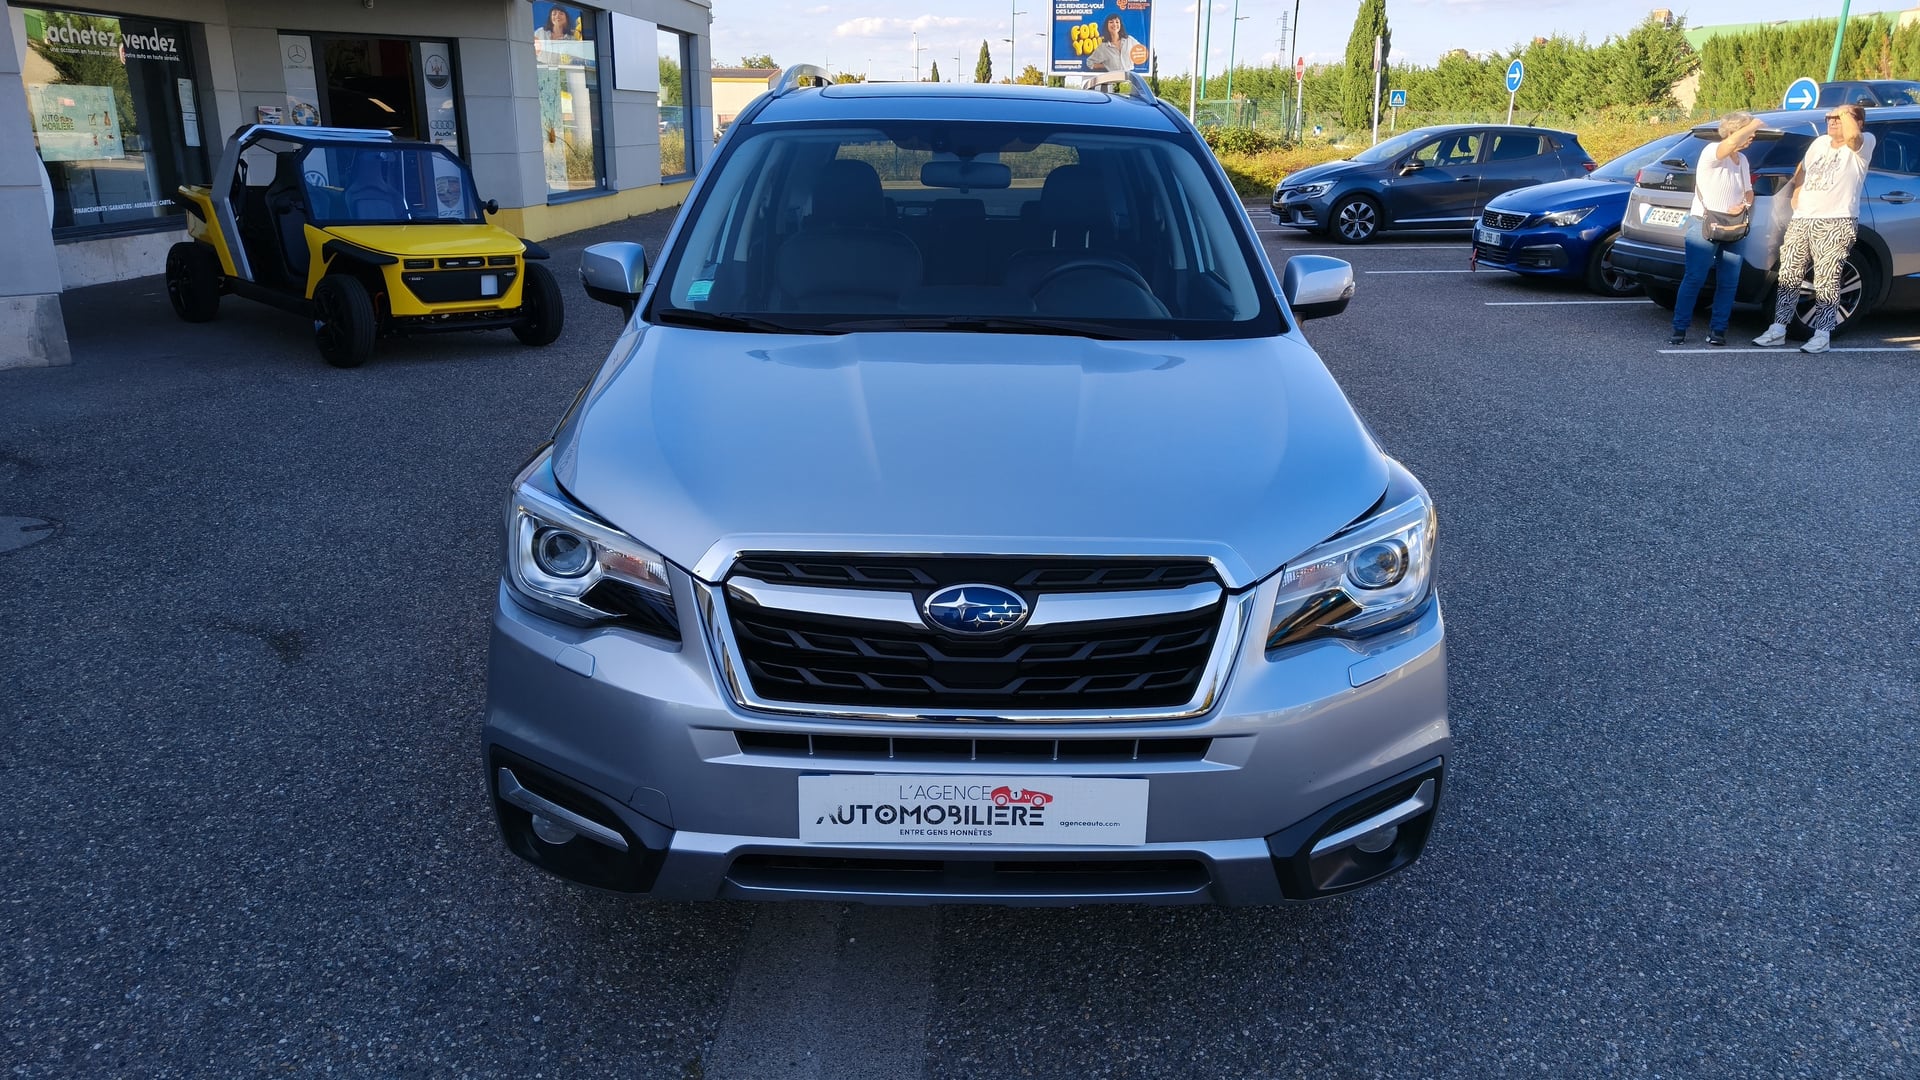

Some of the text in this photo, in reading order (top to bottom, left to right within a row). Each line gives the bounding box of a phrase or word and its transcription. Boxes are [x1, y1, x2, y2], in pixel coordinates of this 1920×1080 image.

[47, 18, 177, 52] achetez vendez
[1071, 22, 1100, 41] FOR
[899, 784, 992, 801] L'AGENCE
[899, 828, 993, 837] ENTRE GENS HONNÊTES
[1059, 820, 1121, 828] agenceauto.com
